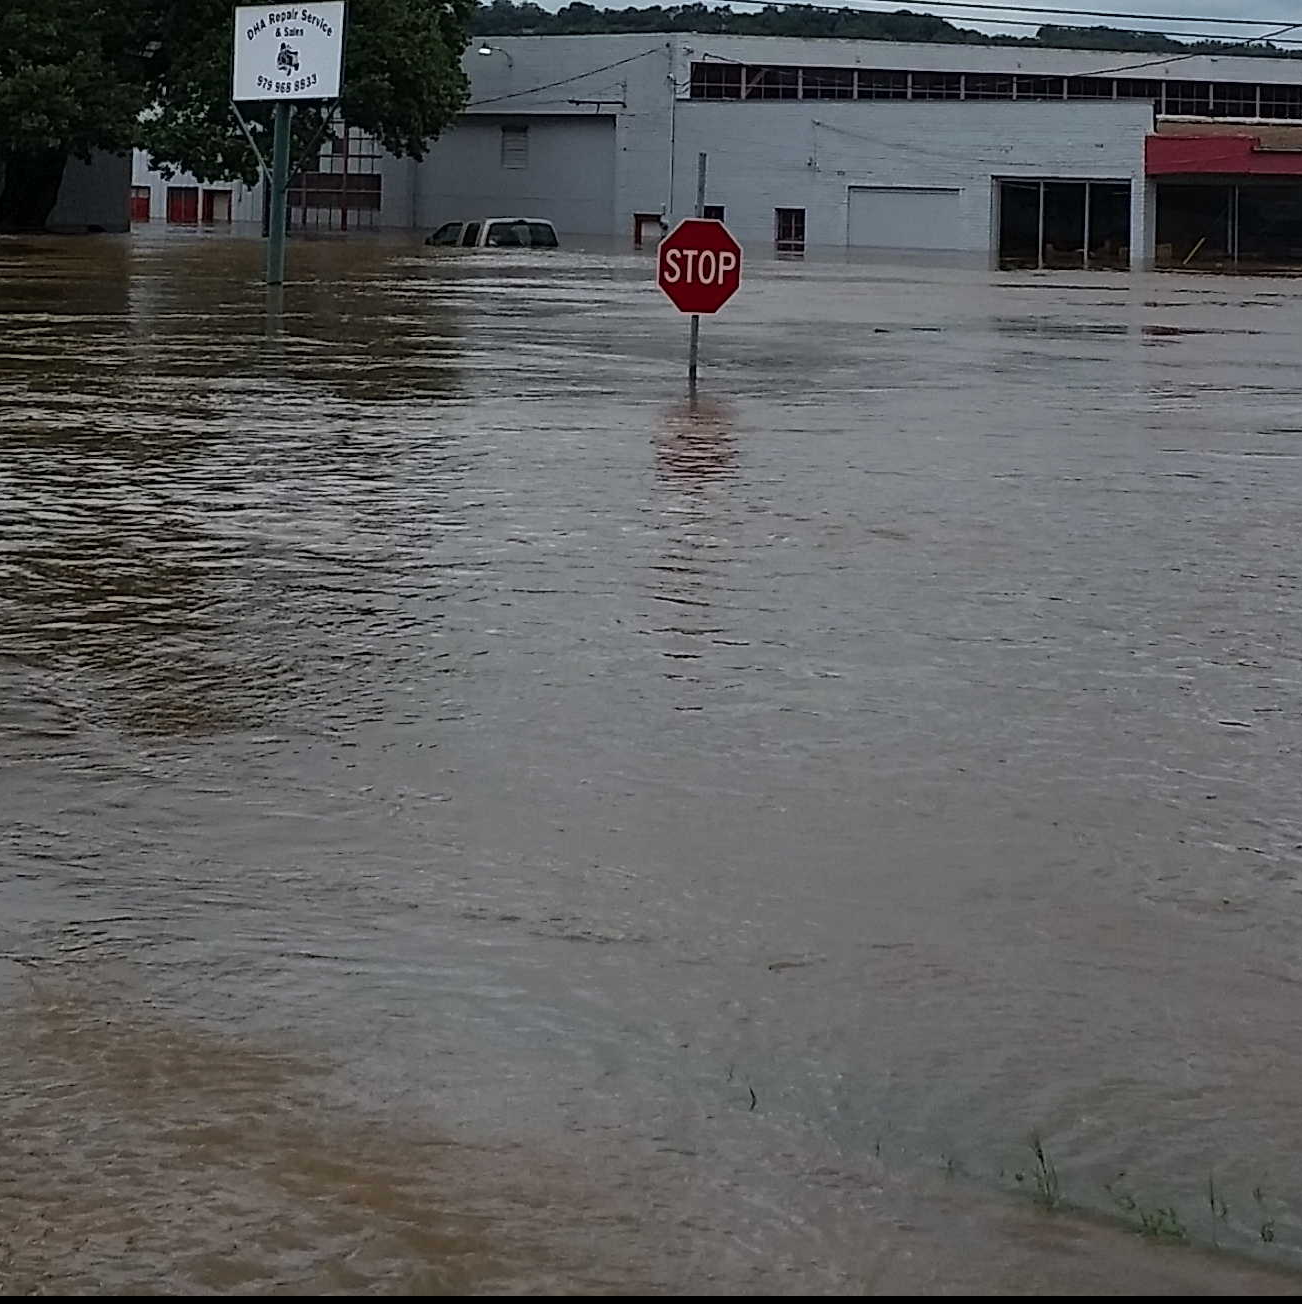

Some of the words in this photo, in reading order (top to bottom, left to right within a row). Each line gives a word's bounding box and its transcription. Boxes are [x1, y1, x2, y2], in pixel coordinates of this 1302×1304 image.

[269, 8, 299, 24] Repair
[301, 9, 333, 37] Service
[275, 27, 282, 37] &
[284, 27, 304, 37] Sales
[664, 248, 736, 284] STOP
